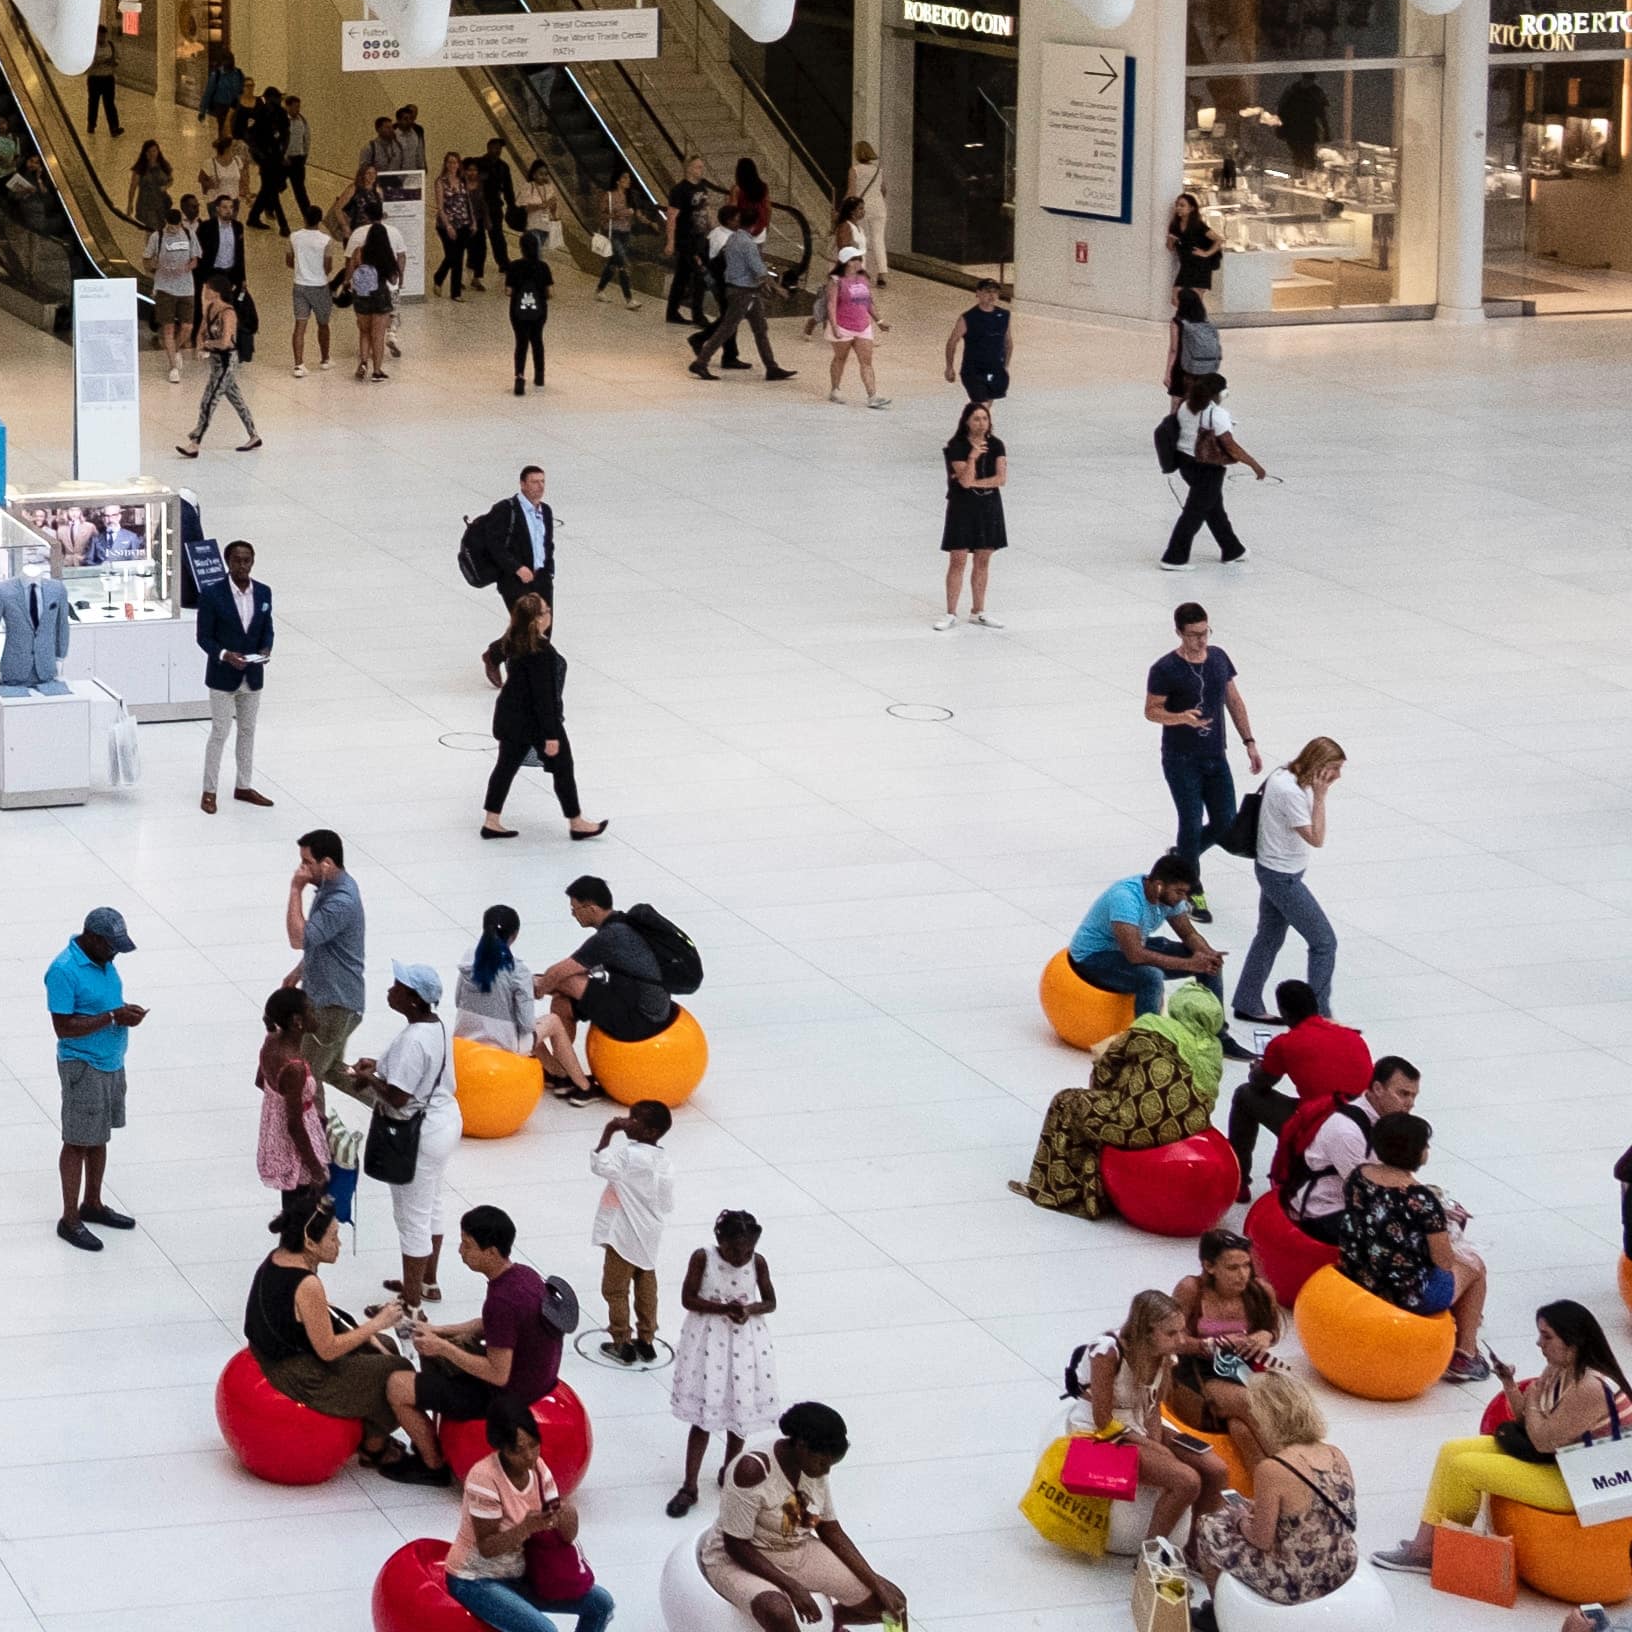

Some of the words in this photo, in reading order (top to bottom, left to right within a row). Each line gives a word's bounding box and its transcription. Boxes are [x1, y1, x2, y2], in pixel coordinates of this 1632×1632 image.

[903, 0, 969, 30] ROBERTO
[971, 10, 1012, 36] COIN
[1520, 10, 1632, 36] ROBERTO
[469, 23, 515, 33] Concourse
[574, 19, 618, 28] Concourse
[451, 39, 475, 47] World
[501, 37, 528, 45] Center
[552, 34, 569, 43] One
[571, 33, 596, 41] World
[597, 32, 620, 40] Trade
[621, 31, 648, 39] Center
[451, 52, 475, 60] World
[477, 51, 499, 59] Trade
[501, 50, 529, 58] Center
